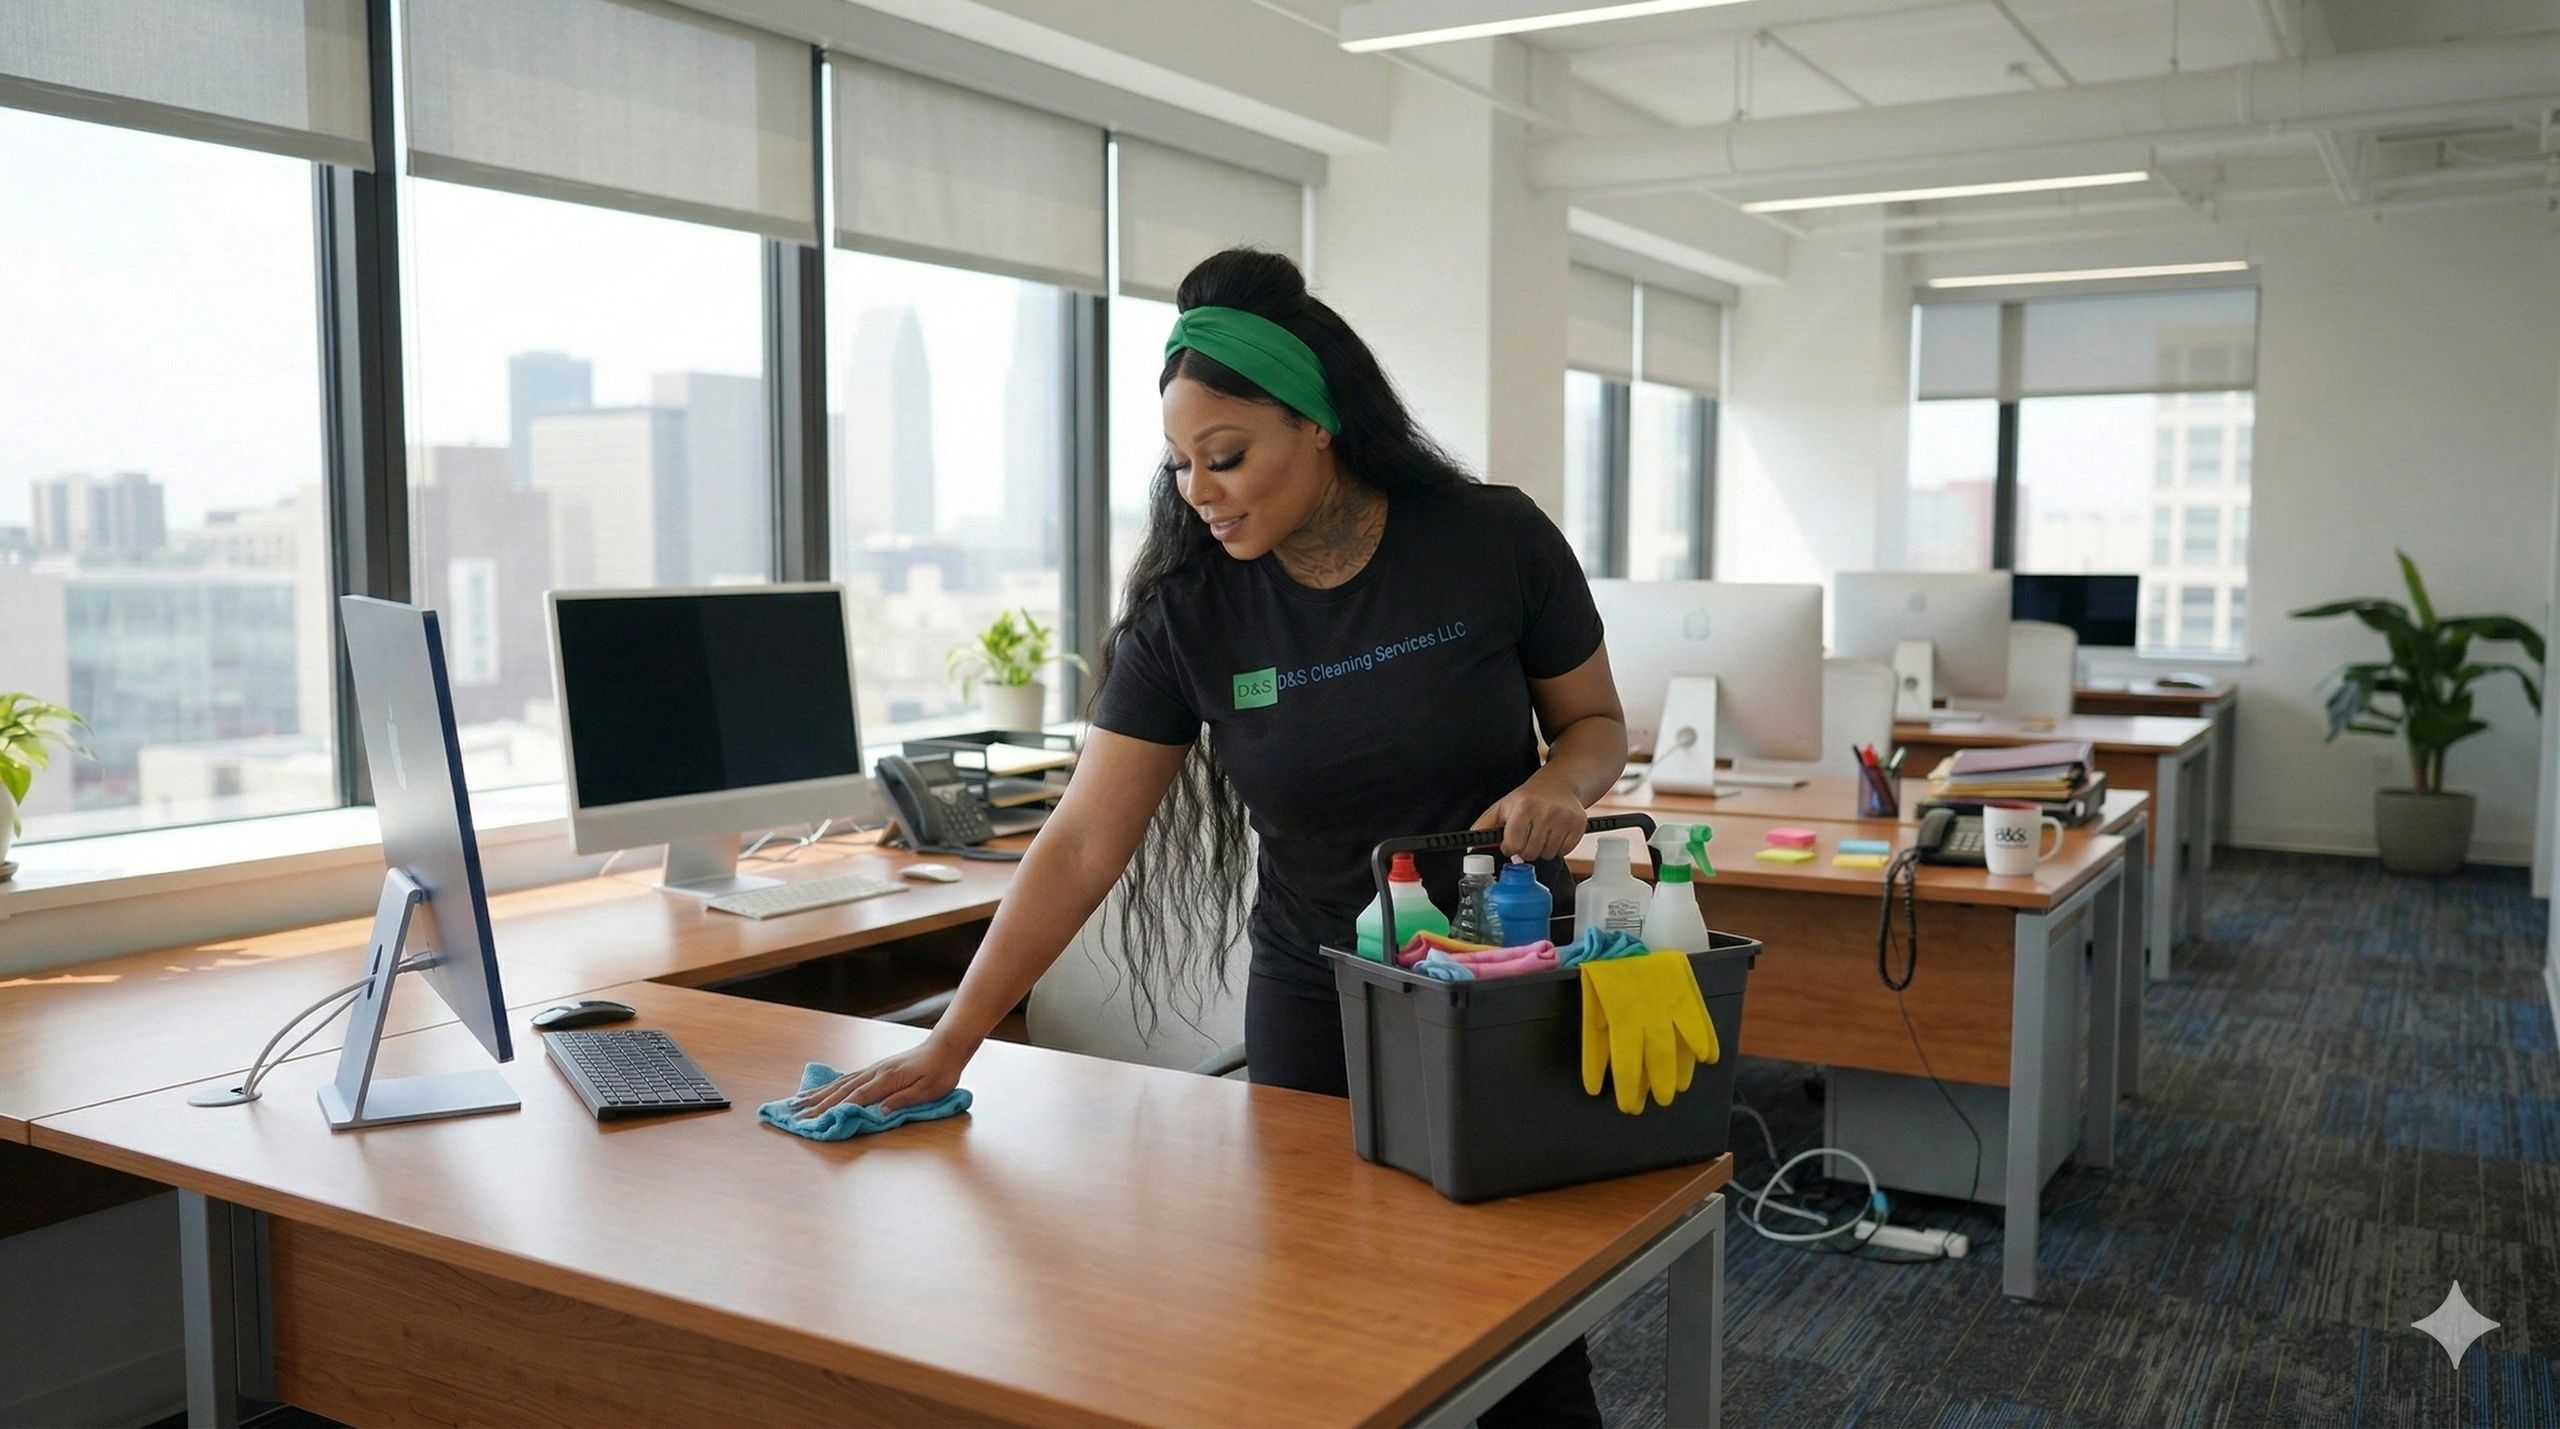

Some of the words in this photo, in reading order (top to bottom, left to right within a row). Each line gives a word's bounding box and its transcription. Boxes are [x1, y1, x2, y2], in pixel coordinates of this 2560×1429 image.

[1278, 669, 1308, 690] D&S
[1311, 653, 1373, 682] Cleaning
[1375, 632, 1436, 662] Services
[1438, 621, 1467, 642] LLC
[1237, 680, 1272, 698] D&S
